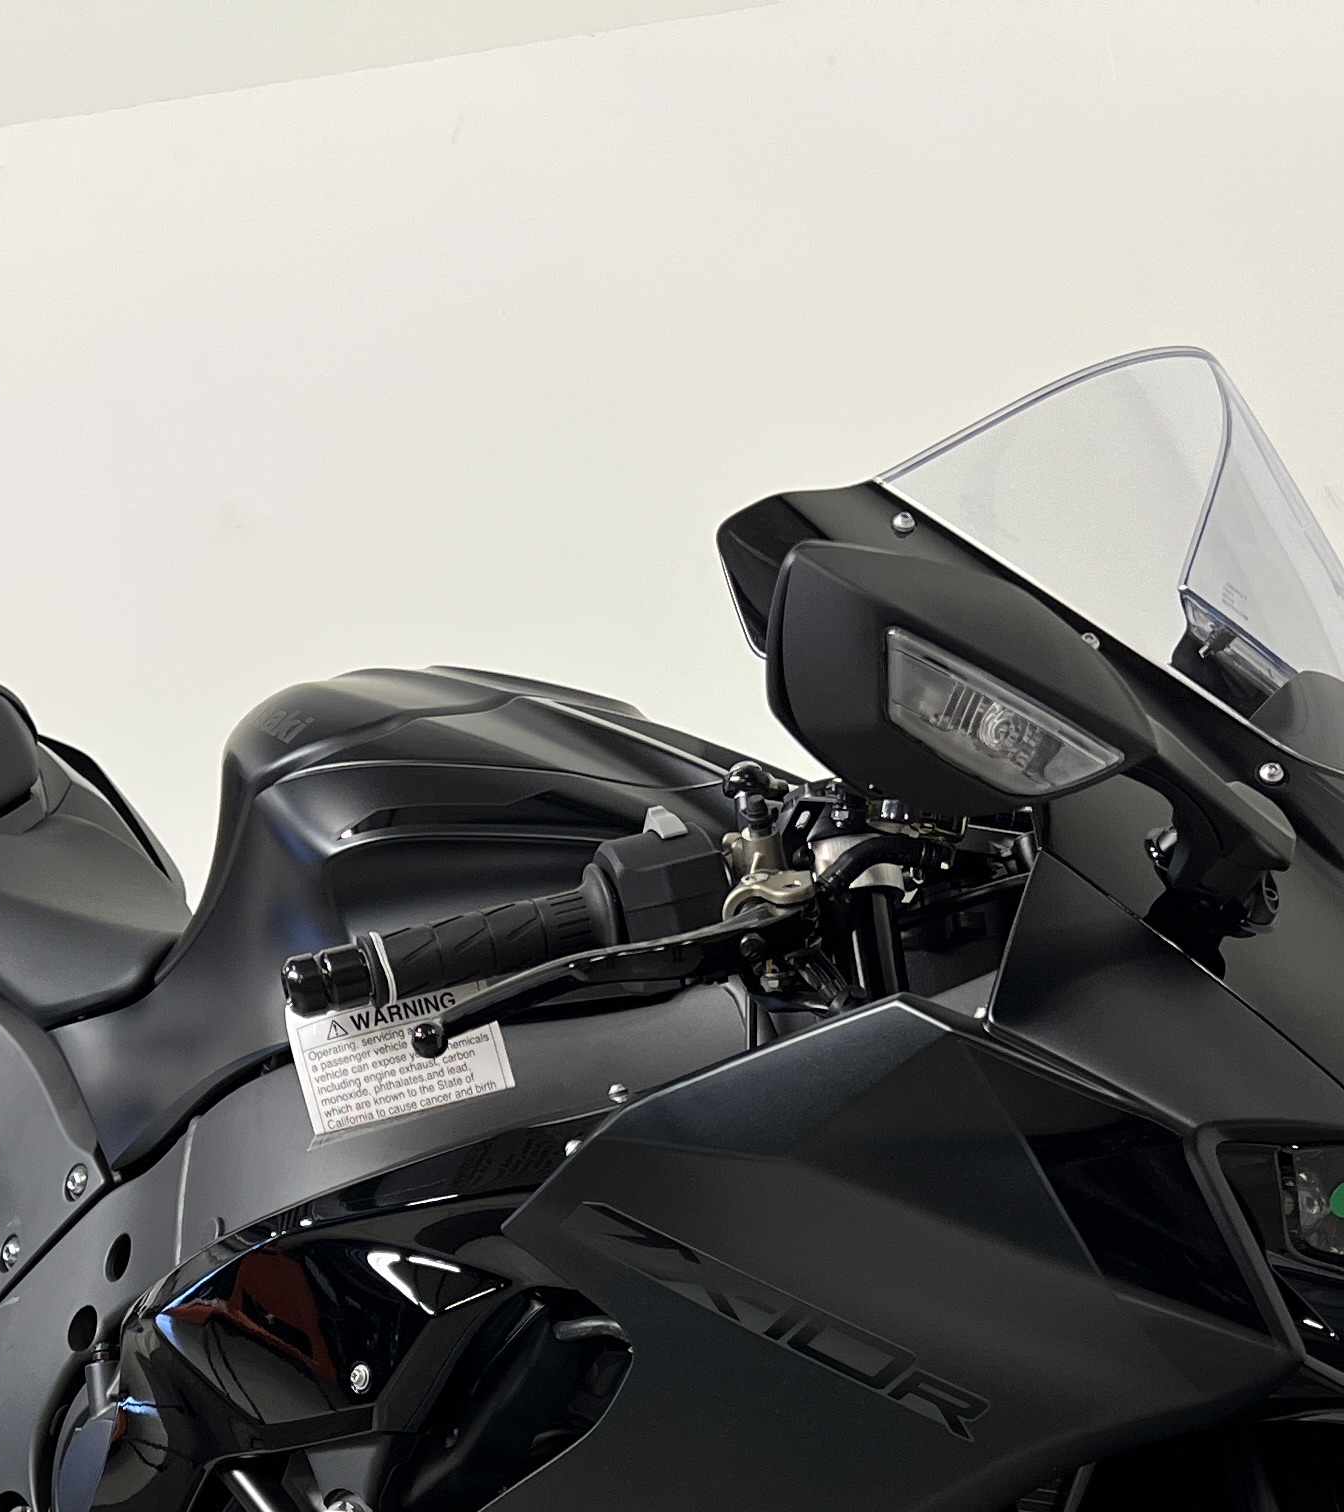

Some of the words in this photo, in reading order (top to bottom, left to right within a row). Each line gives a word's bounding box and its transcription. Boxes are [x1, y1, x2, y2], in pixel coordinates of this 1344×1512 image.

[349, 991, 457, 1031] WARNING
[314, 1068, 349, 1083] vehicle
[351, 1063, 369, 1074] can
[371, 1053, 407, 1069] expose
[446, 1034, 489, 1050] hemicals
[320, 1048, 371, 1072] passenger
[373, 1038, 407, 1055] vehicle
[361, 1029, 405, 1046] servicing
[317, 1077, 362, 1095] including
[363, 1068, 396, 1084] engine
[442, 1049, 475, 1064] carbon
[324, 1103, 353, 1118] which
[355, 1100, 371, 1111] are
[373, 1091, 405, 1106] known
[418, 1084, 435, 1094] the
[437, 1077, 463, 1090] State
[465, 1072, 474, 1083] of
[327, 1112, 375, 1130] California
[388, 1101, 417, 1115] cause
[419, 1092, 452, 1107] cancer
[455, 1085, 473, 1099] and
[474, 1080, 497, 1093] birth
